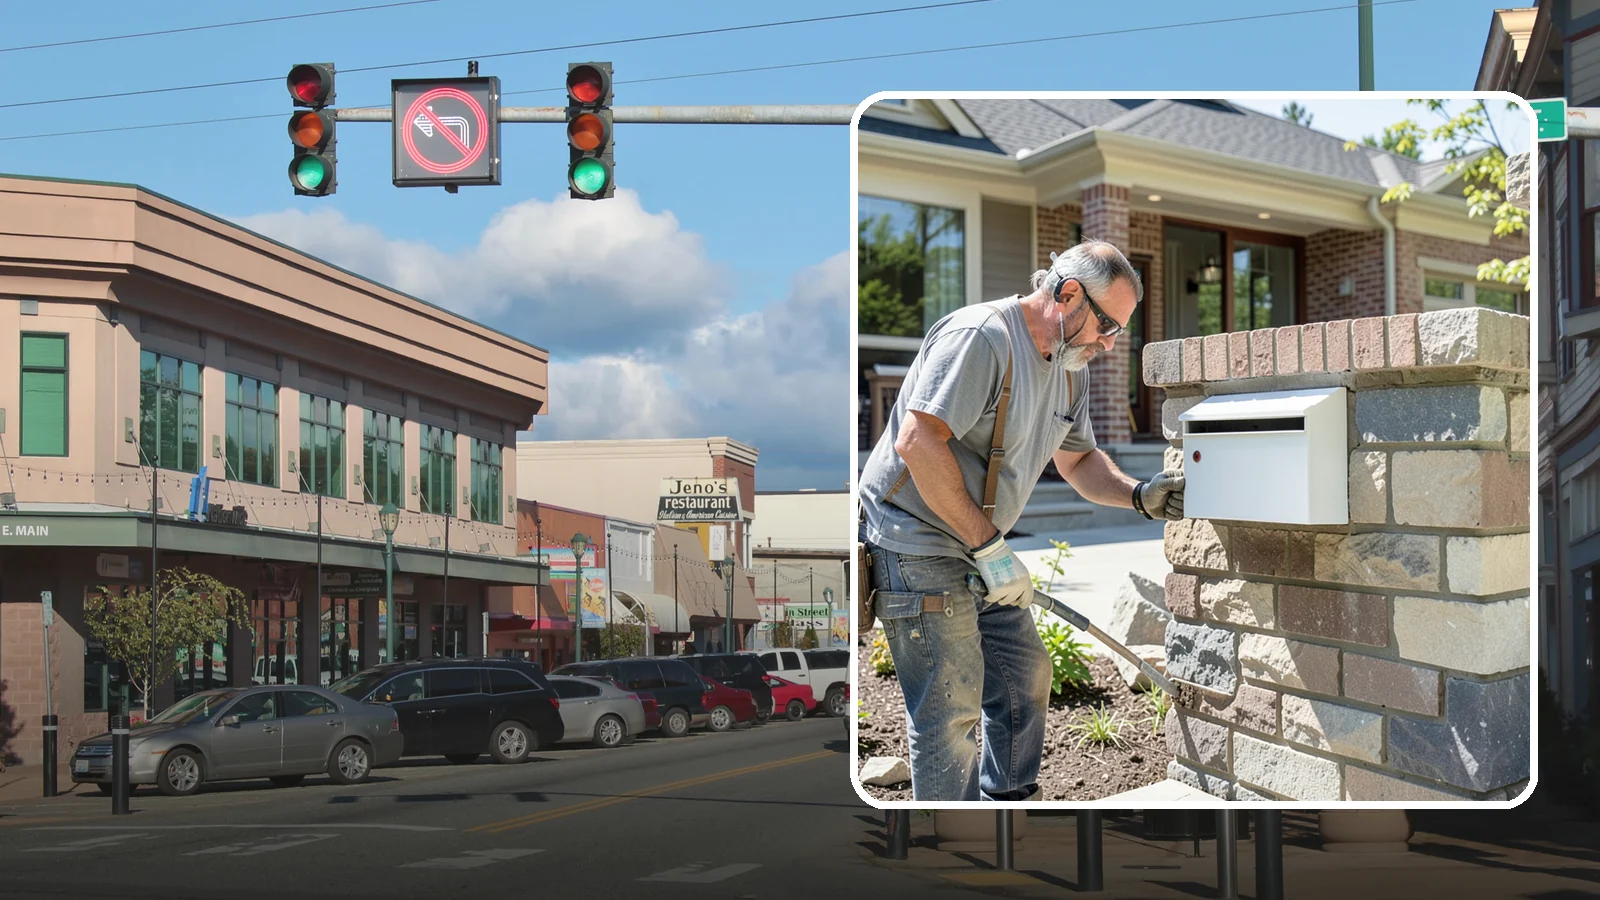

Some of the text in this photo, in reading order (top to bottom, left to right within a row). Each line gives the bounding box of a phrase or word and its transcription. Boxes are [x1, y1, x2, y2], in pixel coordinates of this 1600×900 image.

[669, 479, 727, 495] Jeno's
[665, 496, 731, 509] restaurant
[658, 509, 681, 519] Italian
[686, 509, 714, 519] American
[715, 509, 738, 519] Cuisine
[2, 525, 49, 536] E. MAIN
[797, 607, 829, 617] Street
